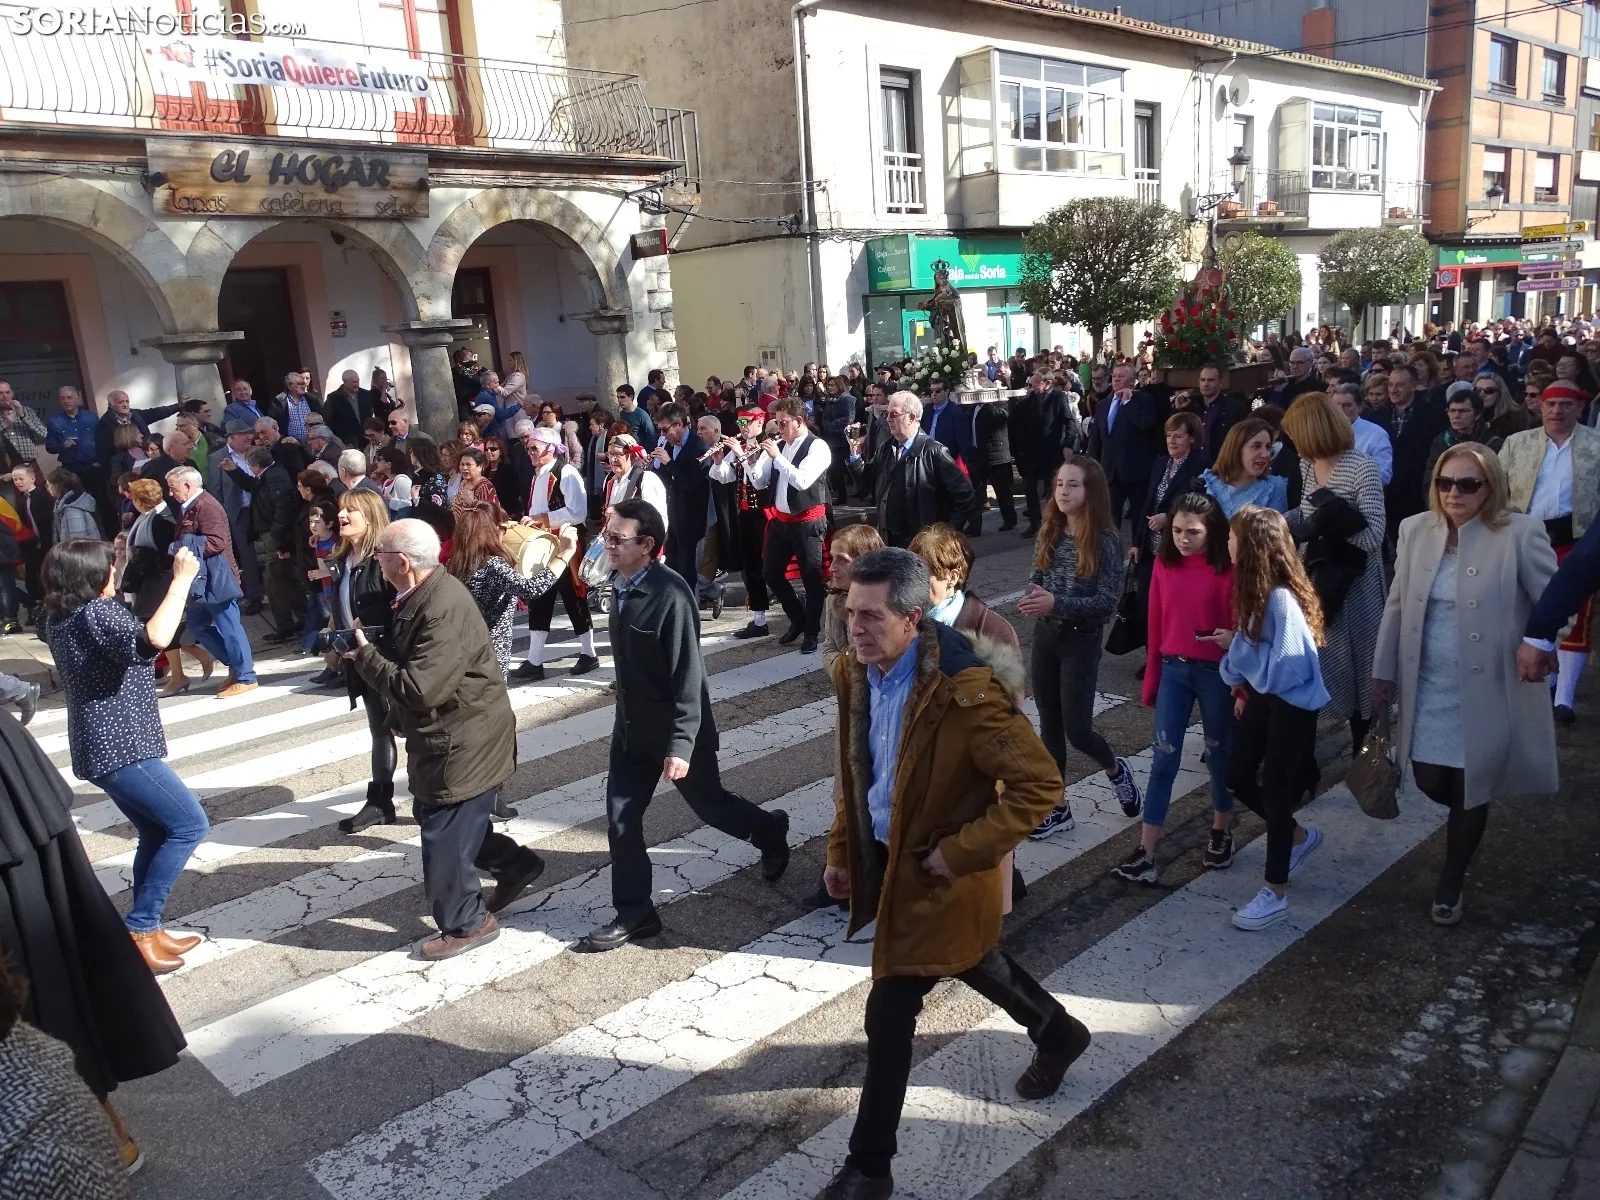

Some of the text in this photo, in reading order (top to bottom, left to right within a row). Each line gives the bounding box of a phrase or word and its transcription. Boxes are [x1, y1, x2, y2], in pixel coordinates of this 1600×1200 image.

[205, 48, 429, 93] #SoriaQuiereFuturo
[269, 152, 390, 194] HOGAR
[636, 236, 660, 248] Mahou
[947, 264, 1006, 284] aja Soria
